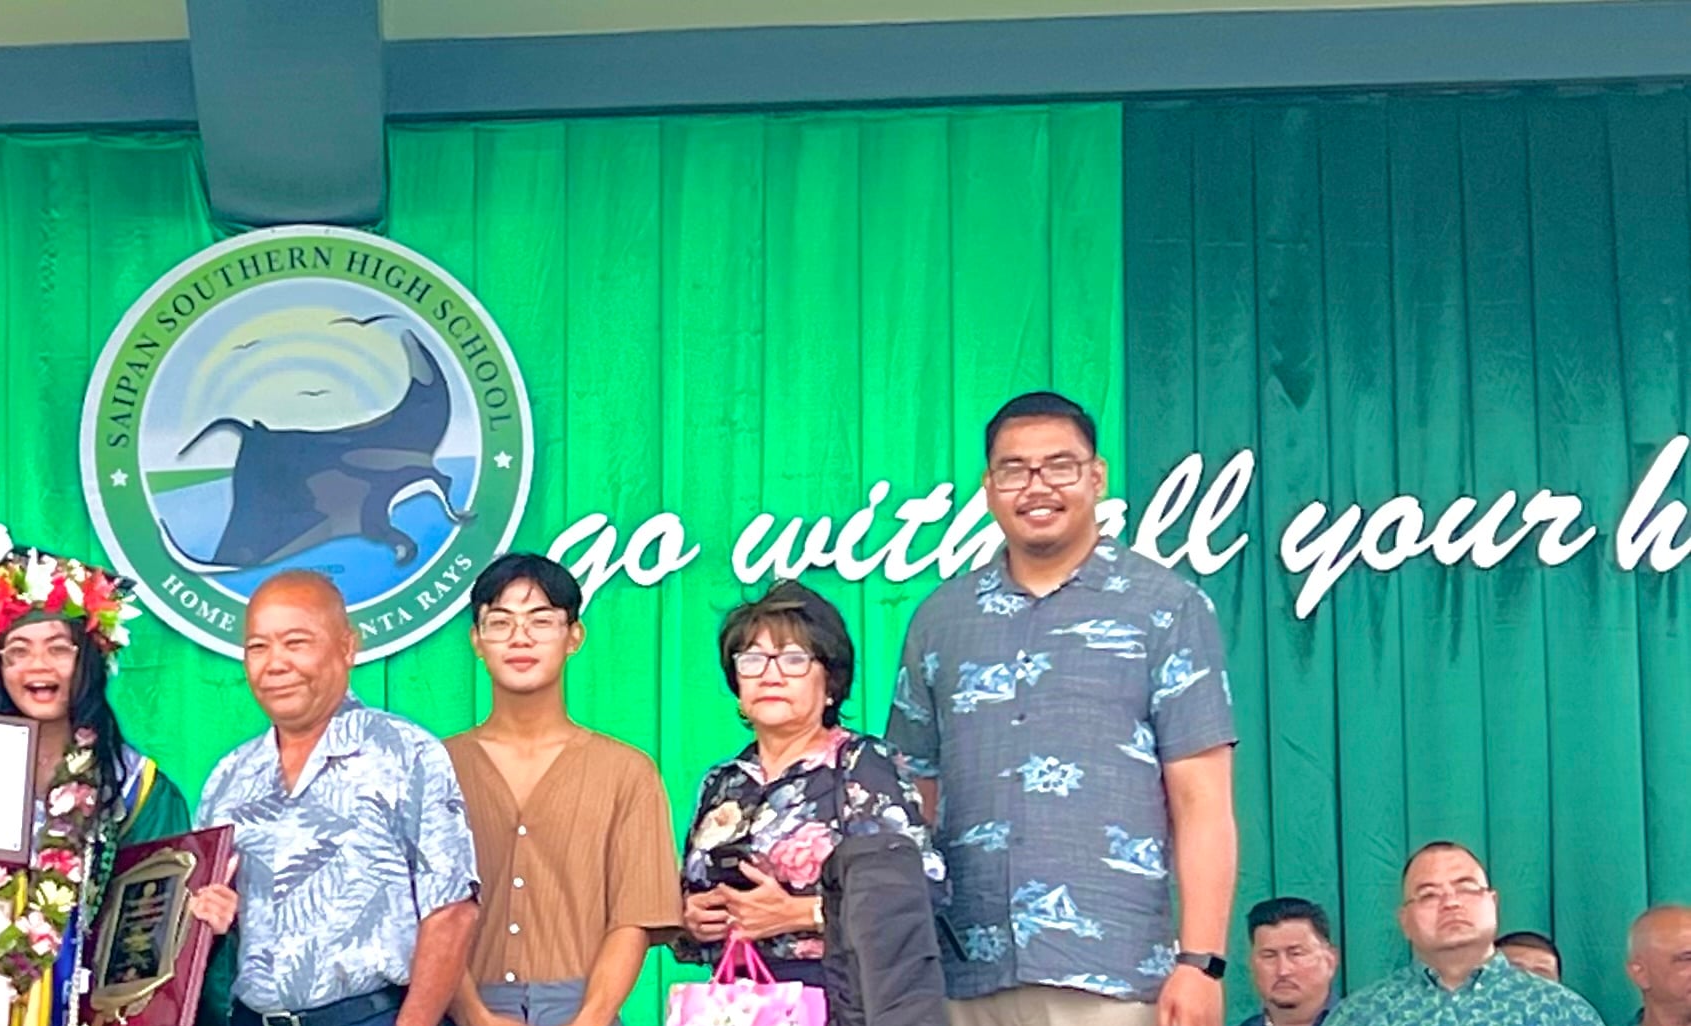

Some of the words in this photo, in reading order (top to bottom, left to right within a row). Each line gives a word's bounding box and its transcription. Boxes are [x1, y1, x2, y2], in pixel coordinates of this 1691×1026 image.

[107, 334, 160, 448] SAIPAN
[157, 245, 331, 332] SOUTHERN
[346, 250, 432, 305] HIGH
[433, 298, 513, 433] SCHOOL
[161, 573, 236, 633] HOME
[414, 553, 473, 611] RAYS
[547, 512, 701, 616] go
[1280, 489, 1597, 620] your
